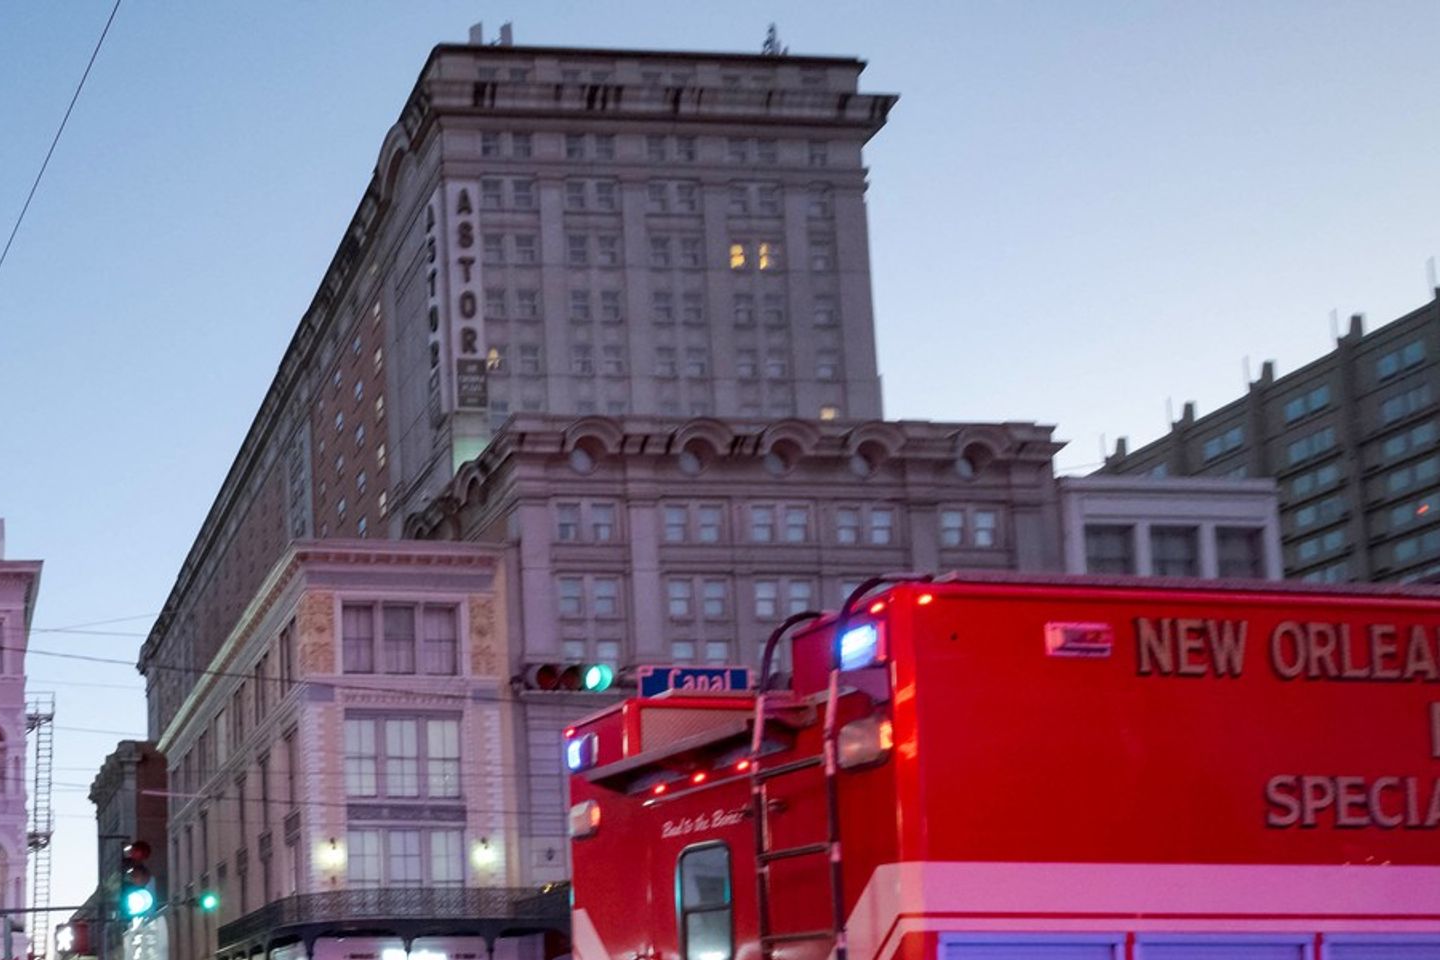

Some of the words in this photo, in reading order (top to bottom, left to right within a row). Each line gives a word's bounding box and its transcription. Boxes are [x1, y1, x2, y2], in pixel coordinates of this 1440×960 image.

[456, 187, 478, 354] ASTOR
[667, 667, 731, 691] Canal
[1135, 617, 1249, 676] NEW
[1270, 620, 1440, 680] ORLEA
